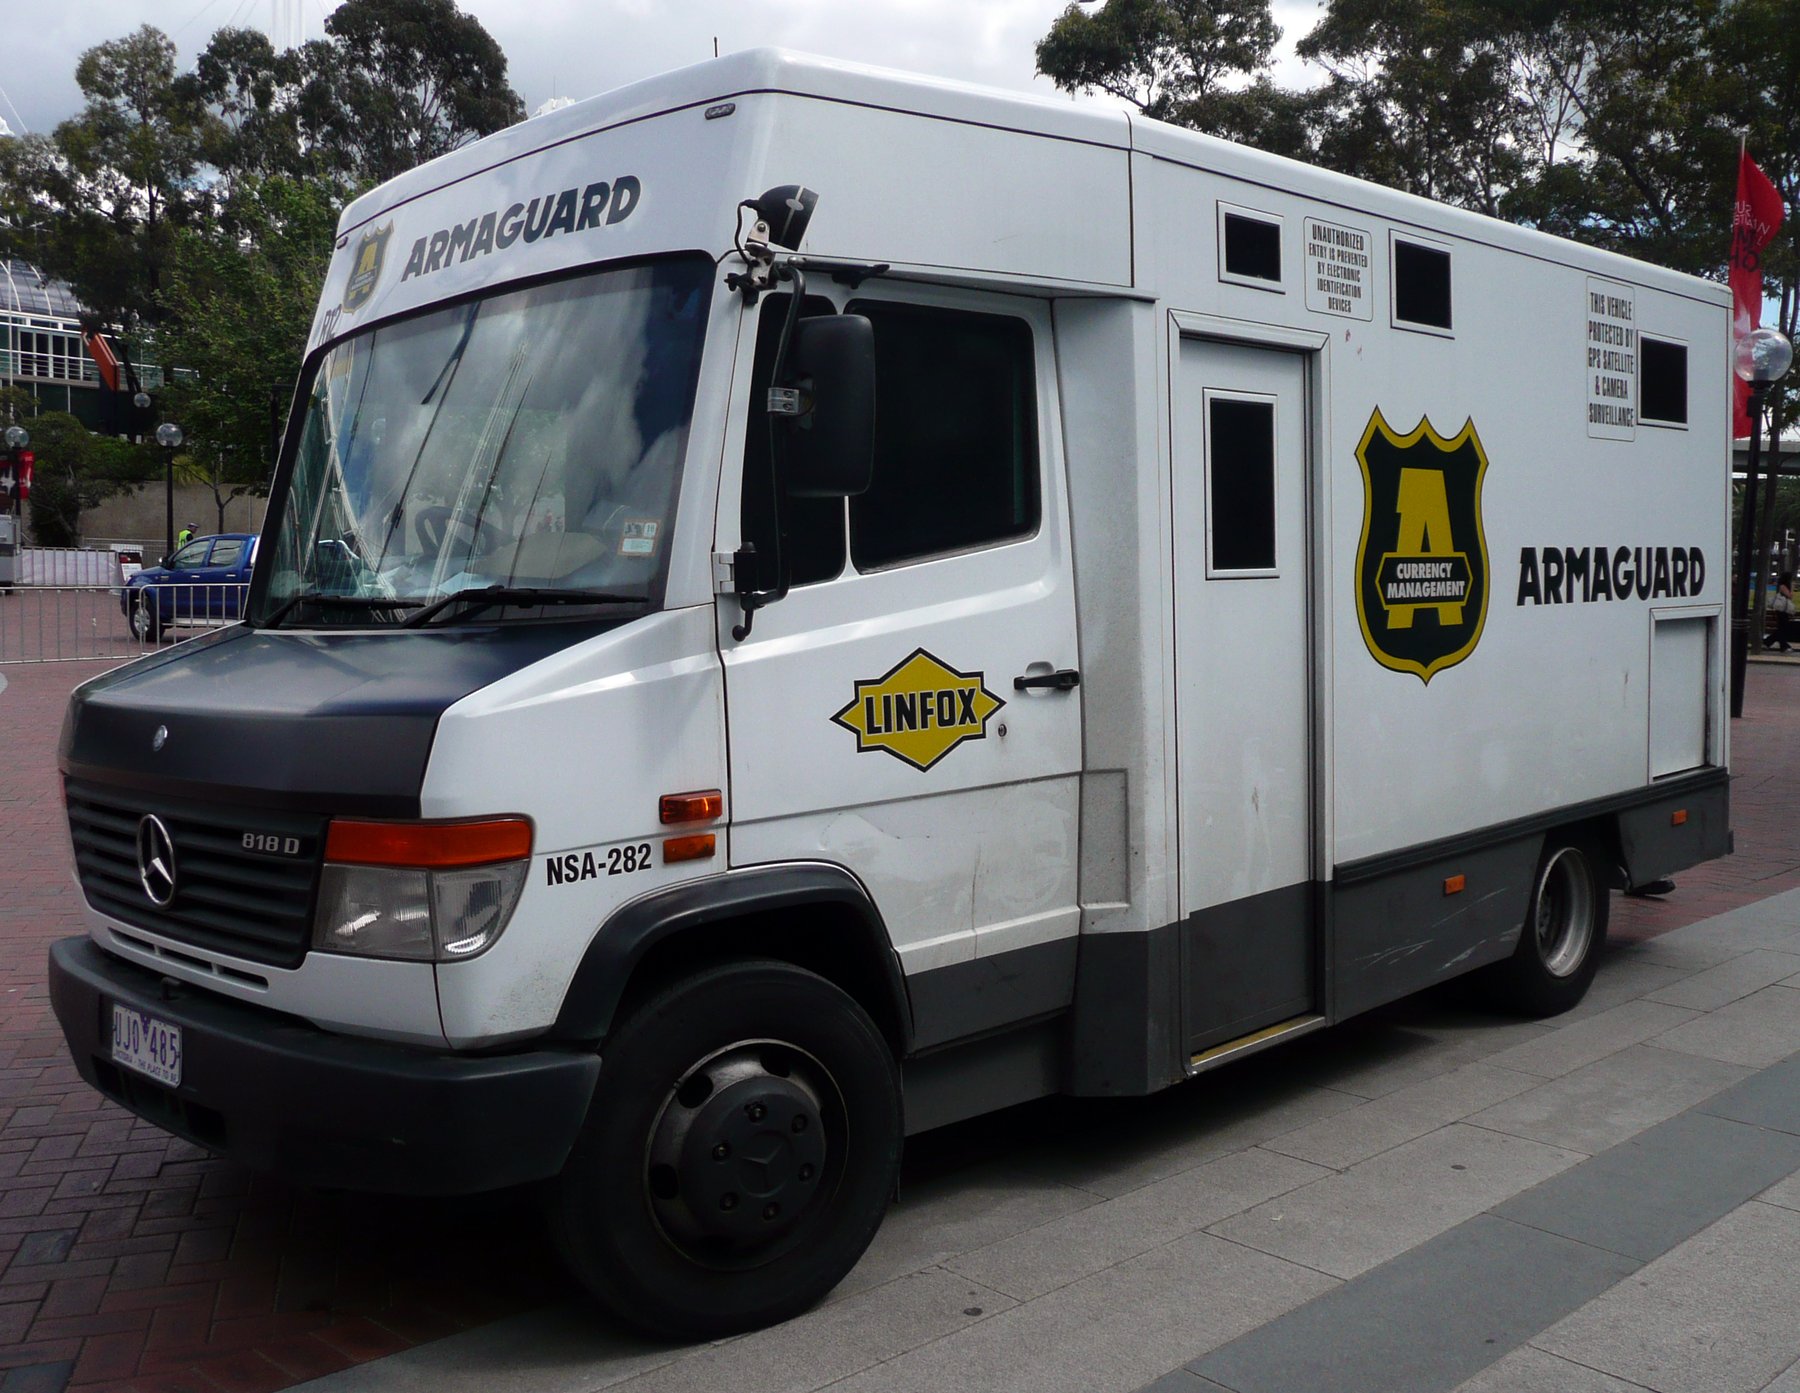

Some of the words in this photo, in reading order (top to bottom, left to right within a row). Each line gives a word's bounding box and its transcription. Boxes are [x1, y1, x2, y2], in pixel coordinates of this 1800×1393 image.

[400, 175, 642, 283] ARMAGUARD
[1312, 224, 1364, 251] UNAUTHORIZED
[1308, 242, 1328, 260] ENTRY
[1329, 247, 1336, 261] IS
[1337, 249, 1368, 267] PREVENTED
[1317, 261, 1326, 275] BY
[1327, 263, 1361, 283] ELECTRONIC
[1317, 277, 1362, 299] IDENTIFICATION
[1328, 296, 1352, 313] DEVICES
[1590, 292, 1606, 316] THIS
[1607, 296, 1632, 321] VEHICLE
[1588, 320, 1624, 346] PROTECTED
[1625, 328, 1634, 348] BY
[1588, 347, 1602, 369] GPS
[1603, 350, 1634, 374] SATELLITE
[1602, 376, 1629, 400] CAMERA
[1589, 403, 1634, 428] SURVEILLANCE
[1396, 562, 1453, 580] CURRENCY
[1516, 545, 1706, 607] ARMAGUARD
[1387, 580, 1466, 599] MANAGEMENT
[865, 687, 978, 735] LINFOX
[242, 832, 280, 852] 818
[283, 837, 300, 854] D
[546, 843, 652, 886] NSA-282
[149, 1026, 177, 1069] 485
